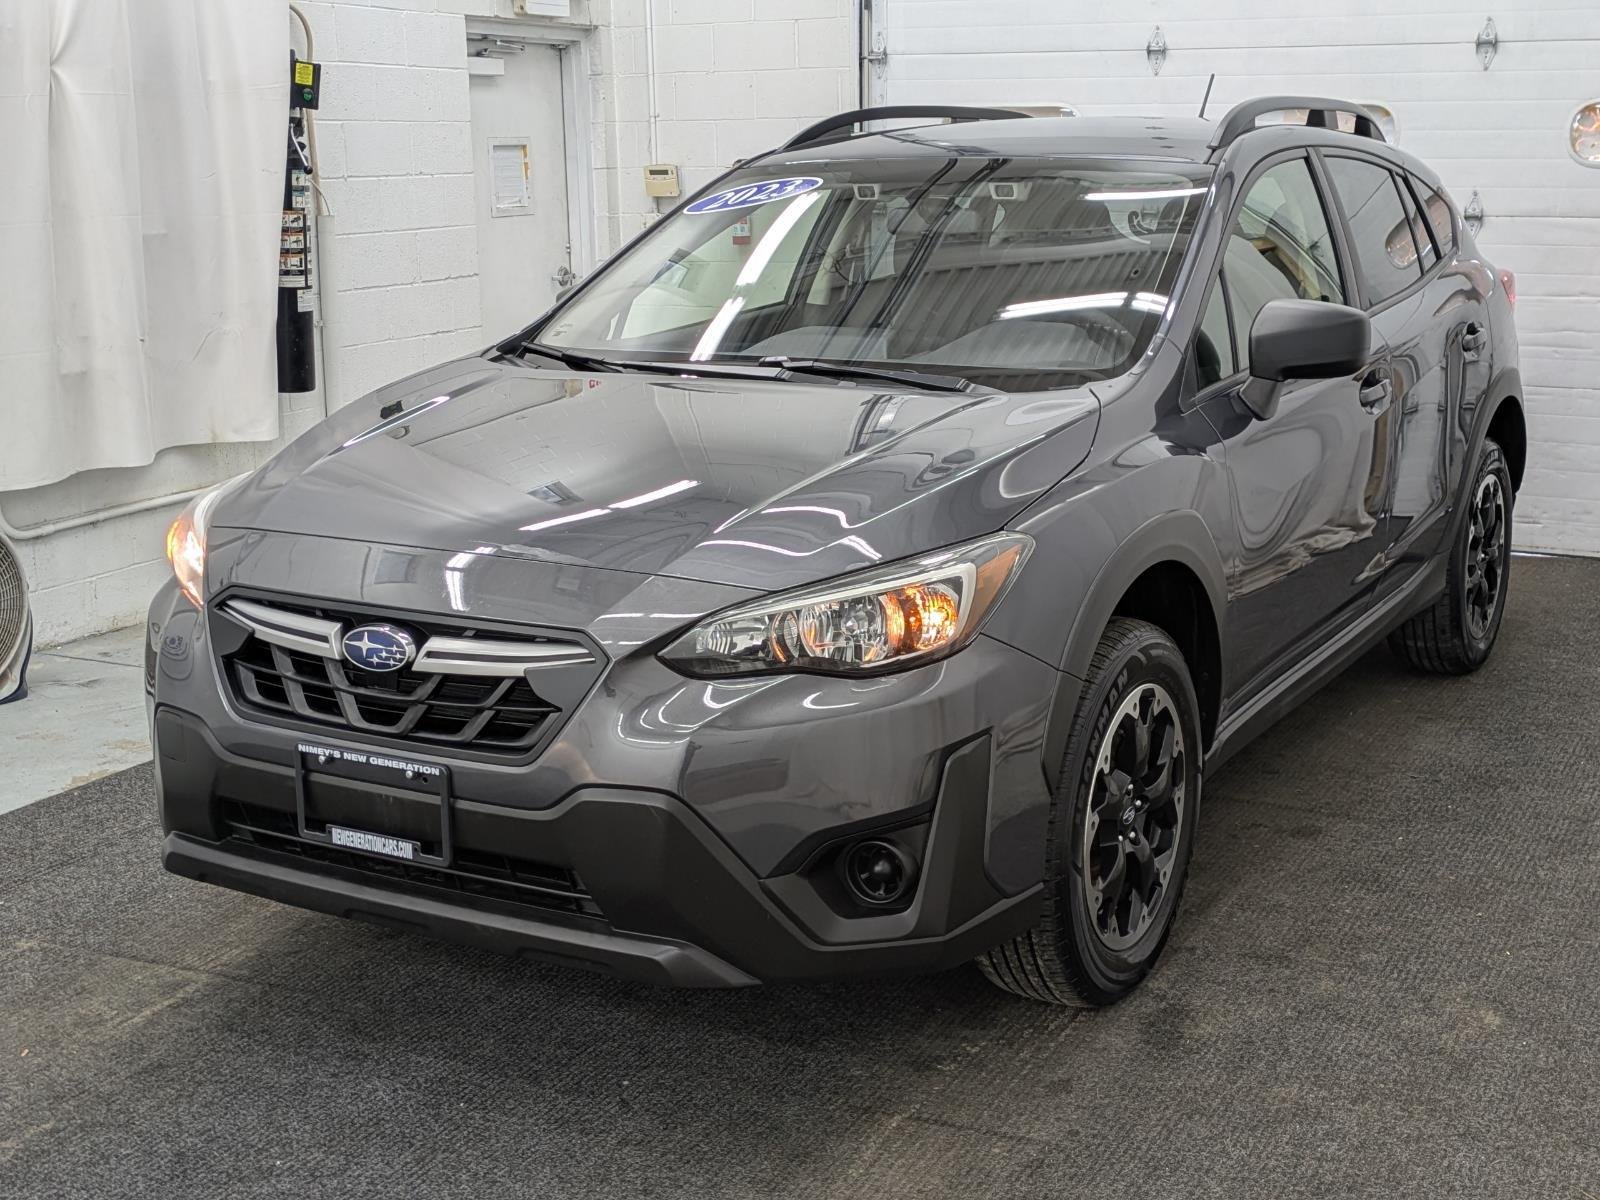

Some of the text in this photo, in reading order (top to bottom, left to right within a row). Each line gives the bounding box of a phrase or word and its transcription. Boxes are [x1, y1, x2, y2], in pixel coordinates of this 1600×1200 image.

[702, 178, 804, 211] 2023
[297, 743, 440, 776] NIMEY'S NEW GENERATION
[331, 827, 413, 860] NEWGENERATIONCARS.COM
